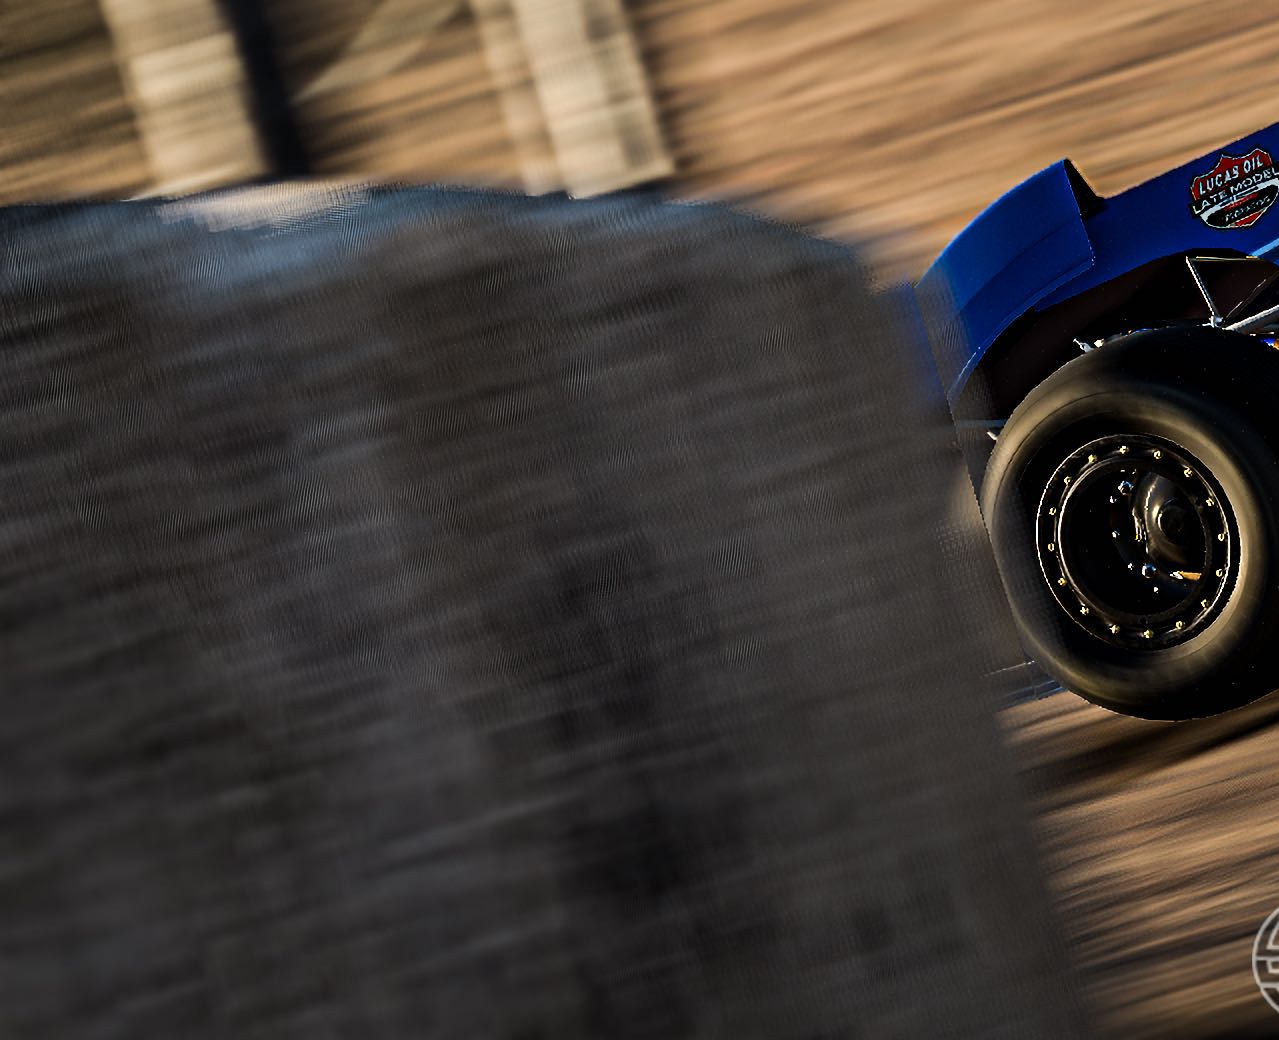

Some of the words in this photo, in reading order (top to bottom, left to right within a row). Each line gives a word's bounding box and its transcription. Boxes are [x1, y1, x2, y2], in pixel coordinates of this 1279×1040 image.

[1199, 165, 1239, 195] LUCAS
[1243, 154, 1264, 173] OIL
[1192, 189, 1228, 215] LATE
